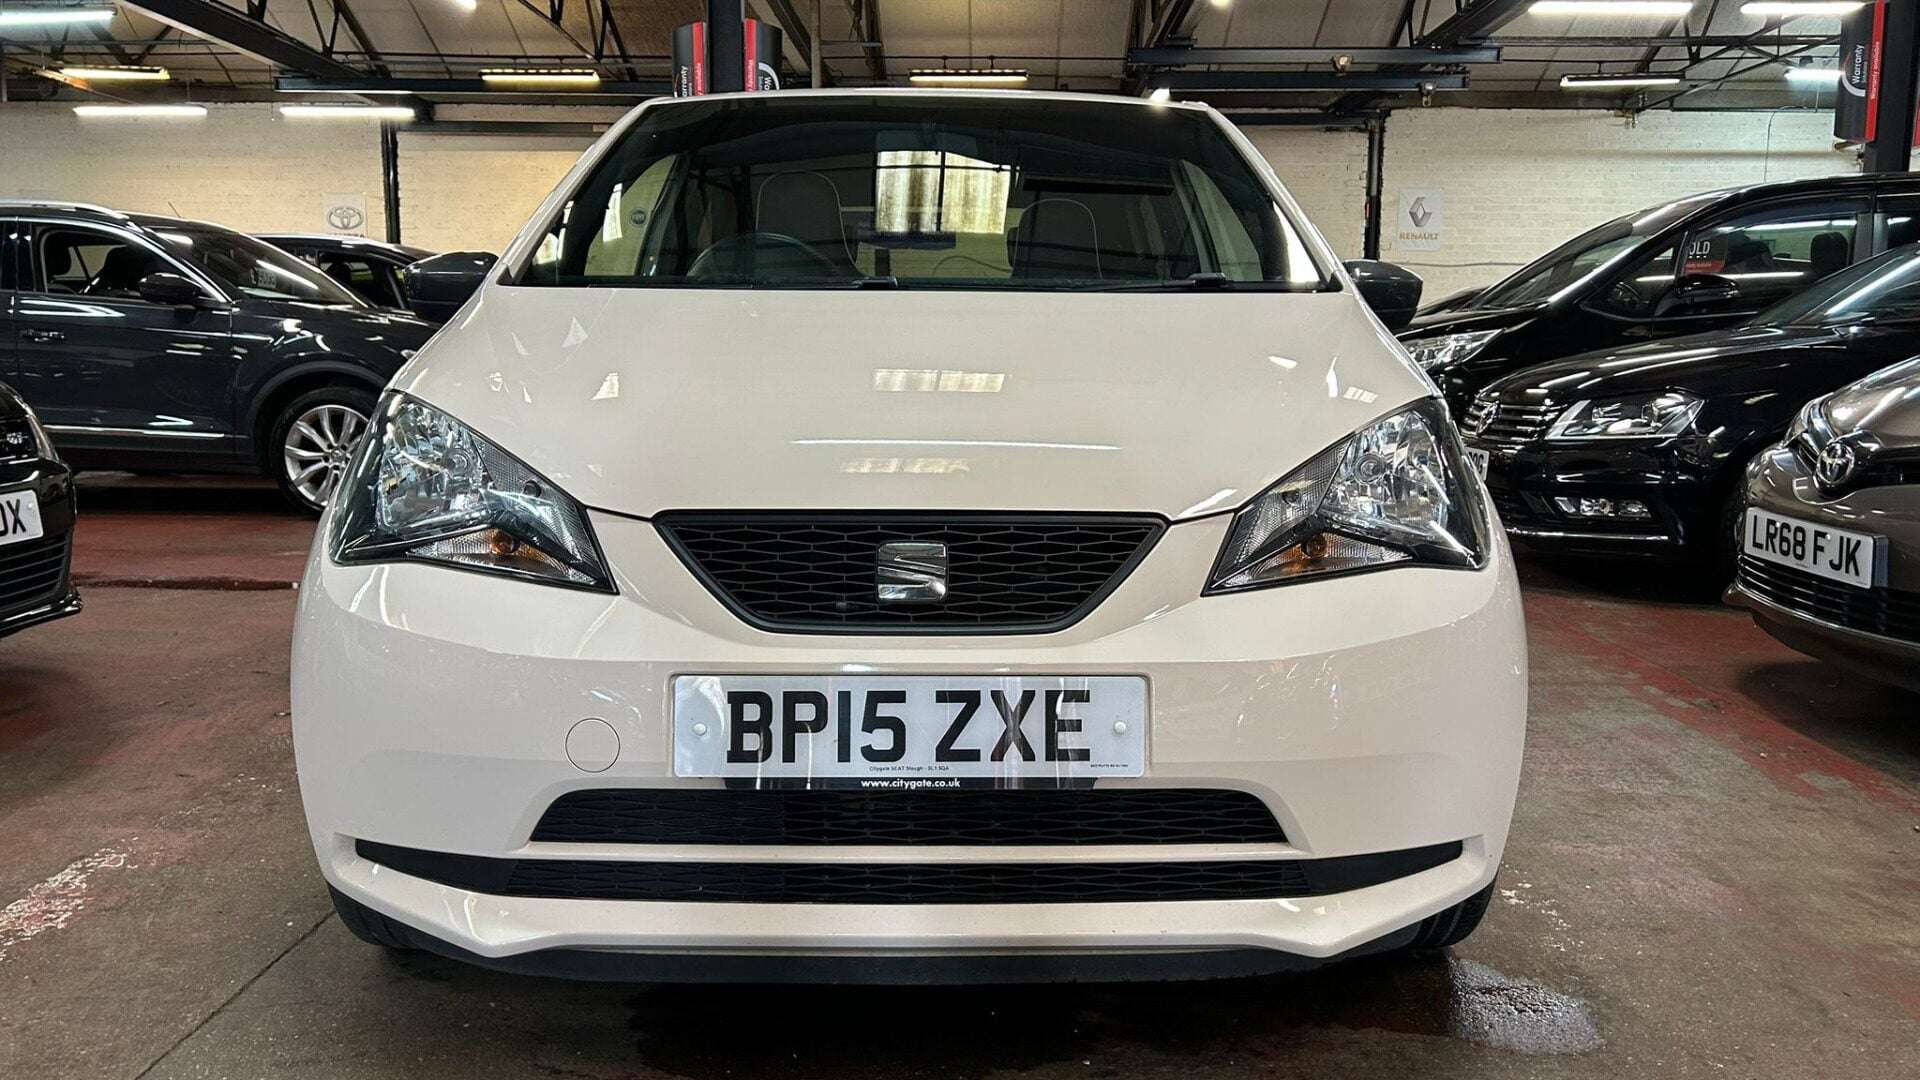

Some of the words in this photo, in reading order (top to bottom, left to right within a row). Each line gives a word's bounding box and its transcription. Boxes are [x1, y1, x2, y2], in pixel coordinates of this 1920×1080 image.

[1851, 45, 1865, 84] Warranty
[1399, 231, 1439, 240] RENAULT
[1752, 514, 1806, 561] LR68
[1813, 529, 1862, 577] FJK
[727, 690, 907, 763] BP15
[935, 690, 1091, 762] ZXE
[860, 777, 961, 790] www.citygate.co.uk
